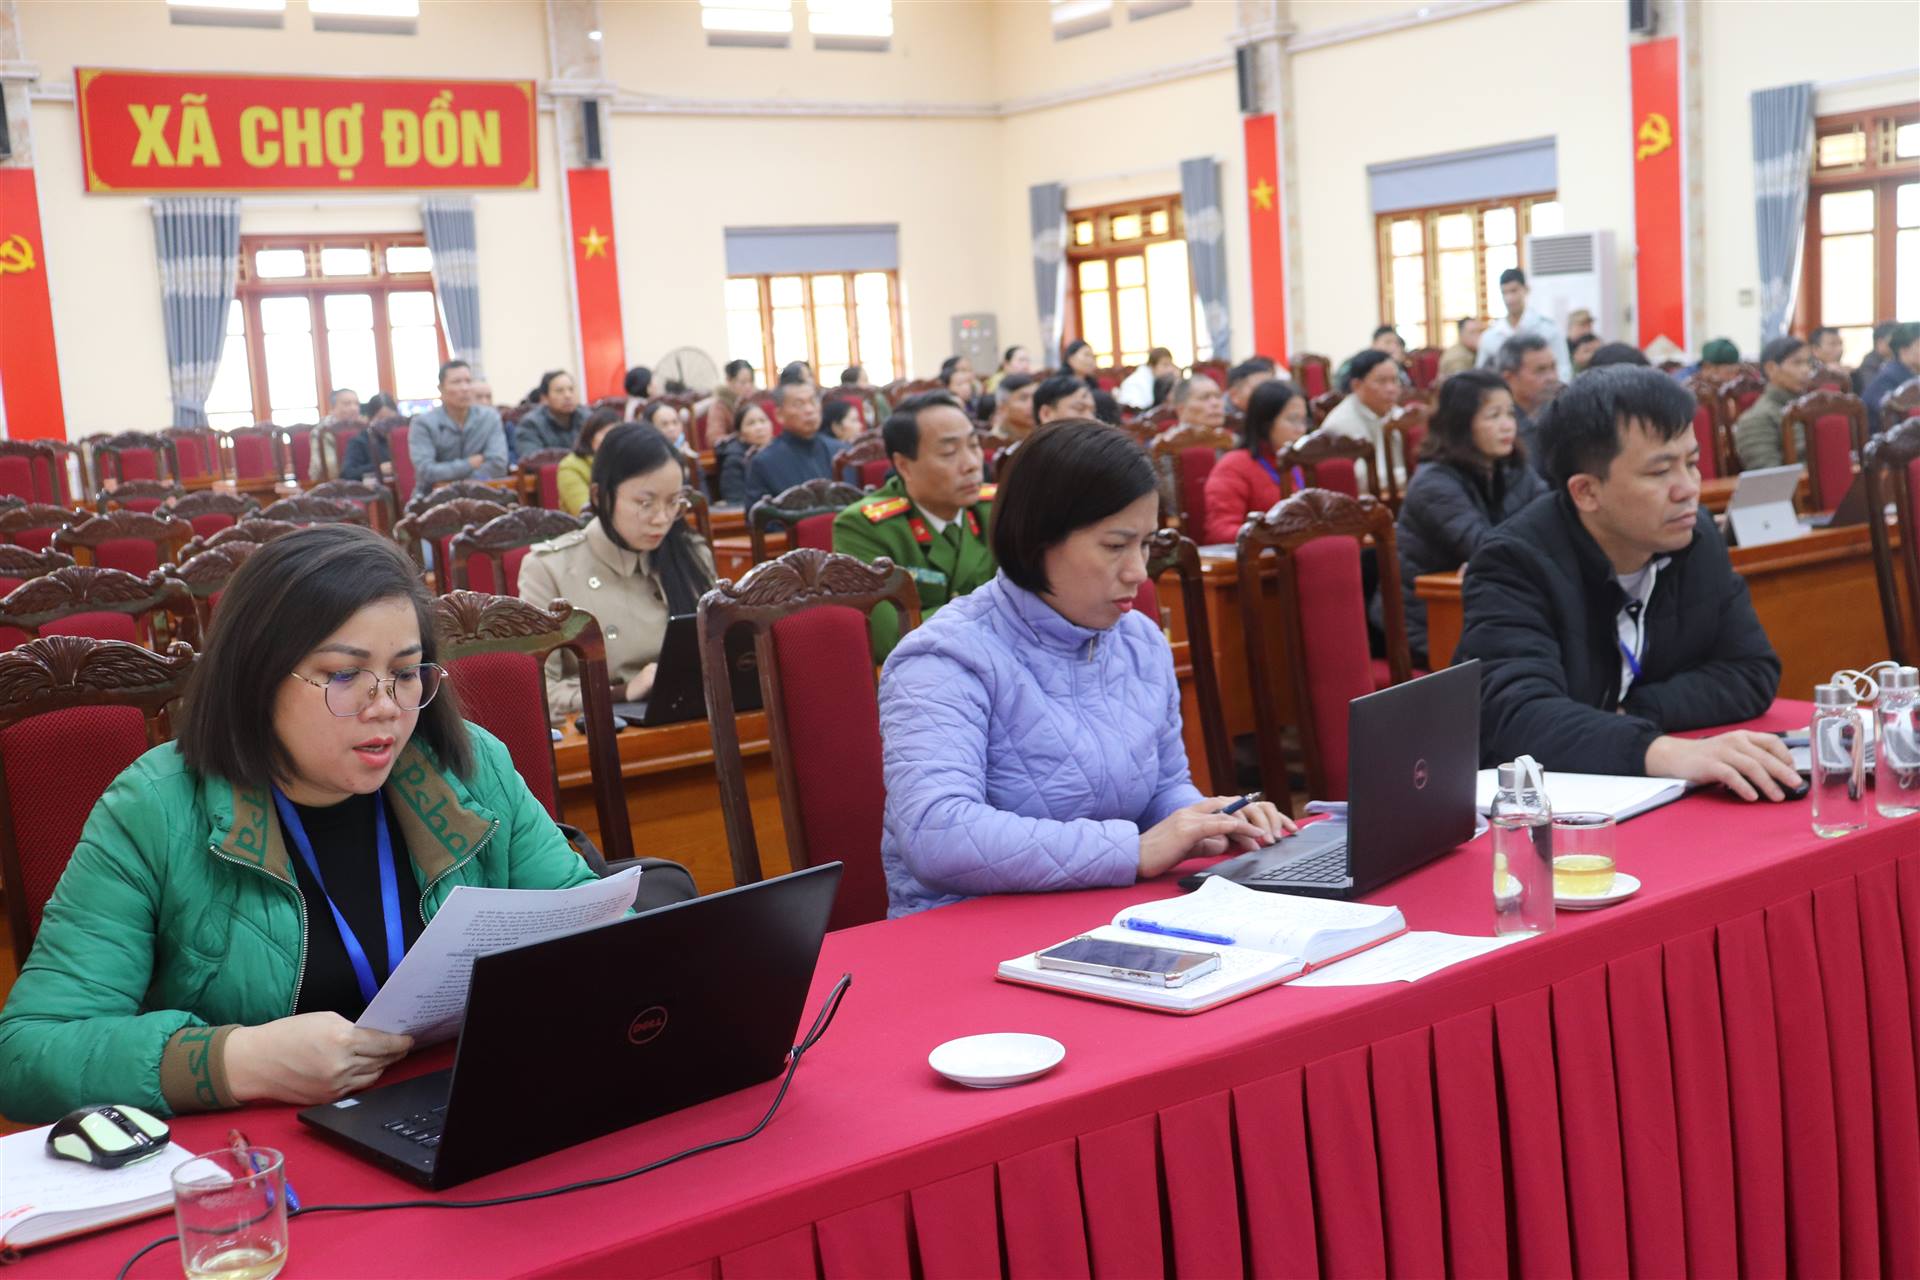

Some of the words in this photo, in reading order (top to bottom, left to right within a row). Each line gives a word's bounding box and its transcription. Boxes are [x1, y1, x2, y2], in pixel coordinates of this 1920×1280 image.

[128, 93, 221, 167] XÃ
[239, 102, 364, 180] CHỢ
[381, 90, 501, 168] ĐỒN
